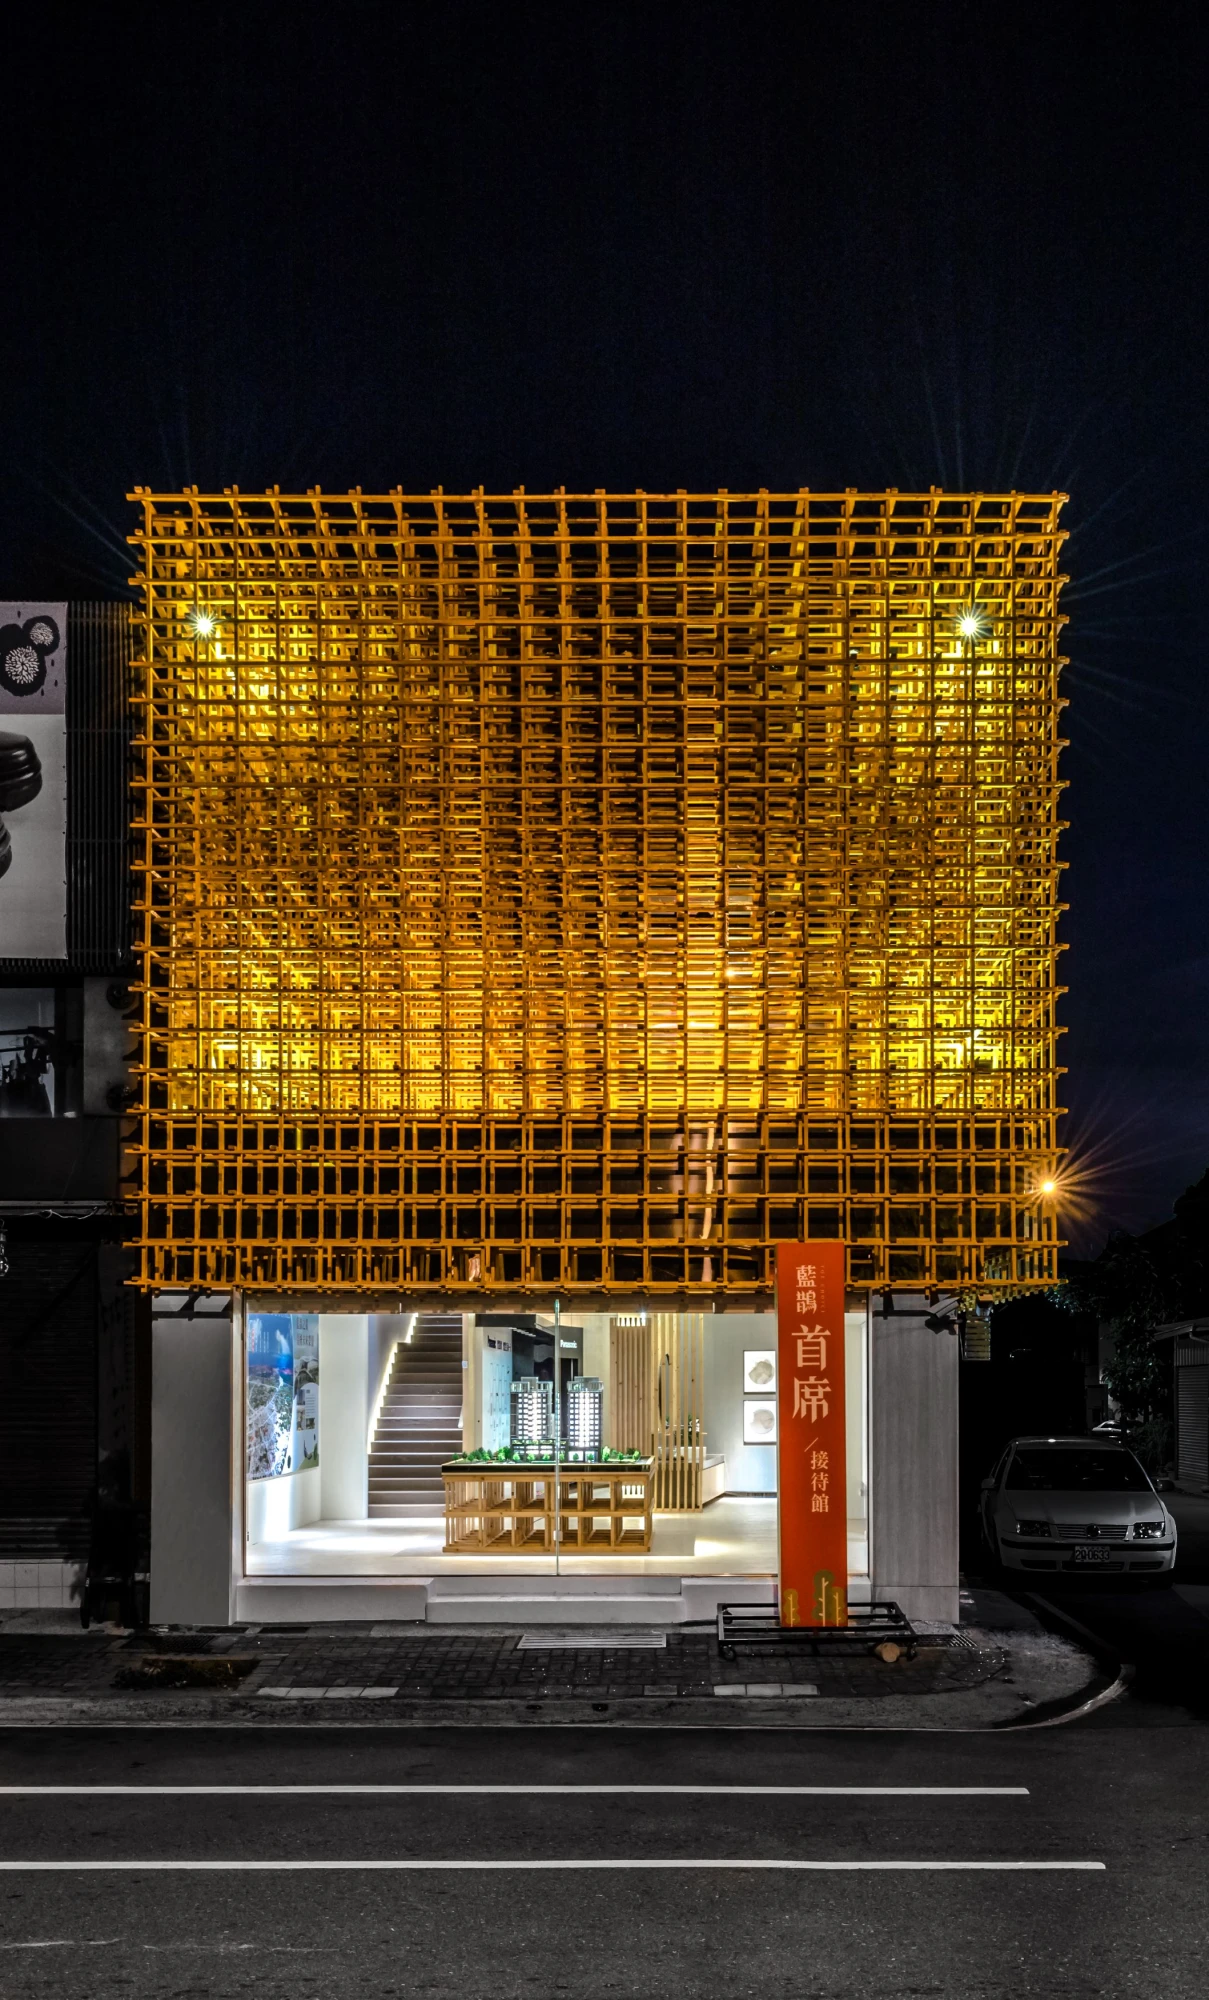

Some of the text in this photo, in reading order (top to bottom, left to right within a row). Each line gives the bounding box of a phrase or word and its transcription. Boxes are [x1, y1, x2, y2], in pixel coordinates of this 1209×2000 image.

[796, 1265, 818, 1315] 藍鵲
[791, 1324, 832, 1424] 首席
[810, 1450, 830, 1513] 接待館
